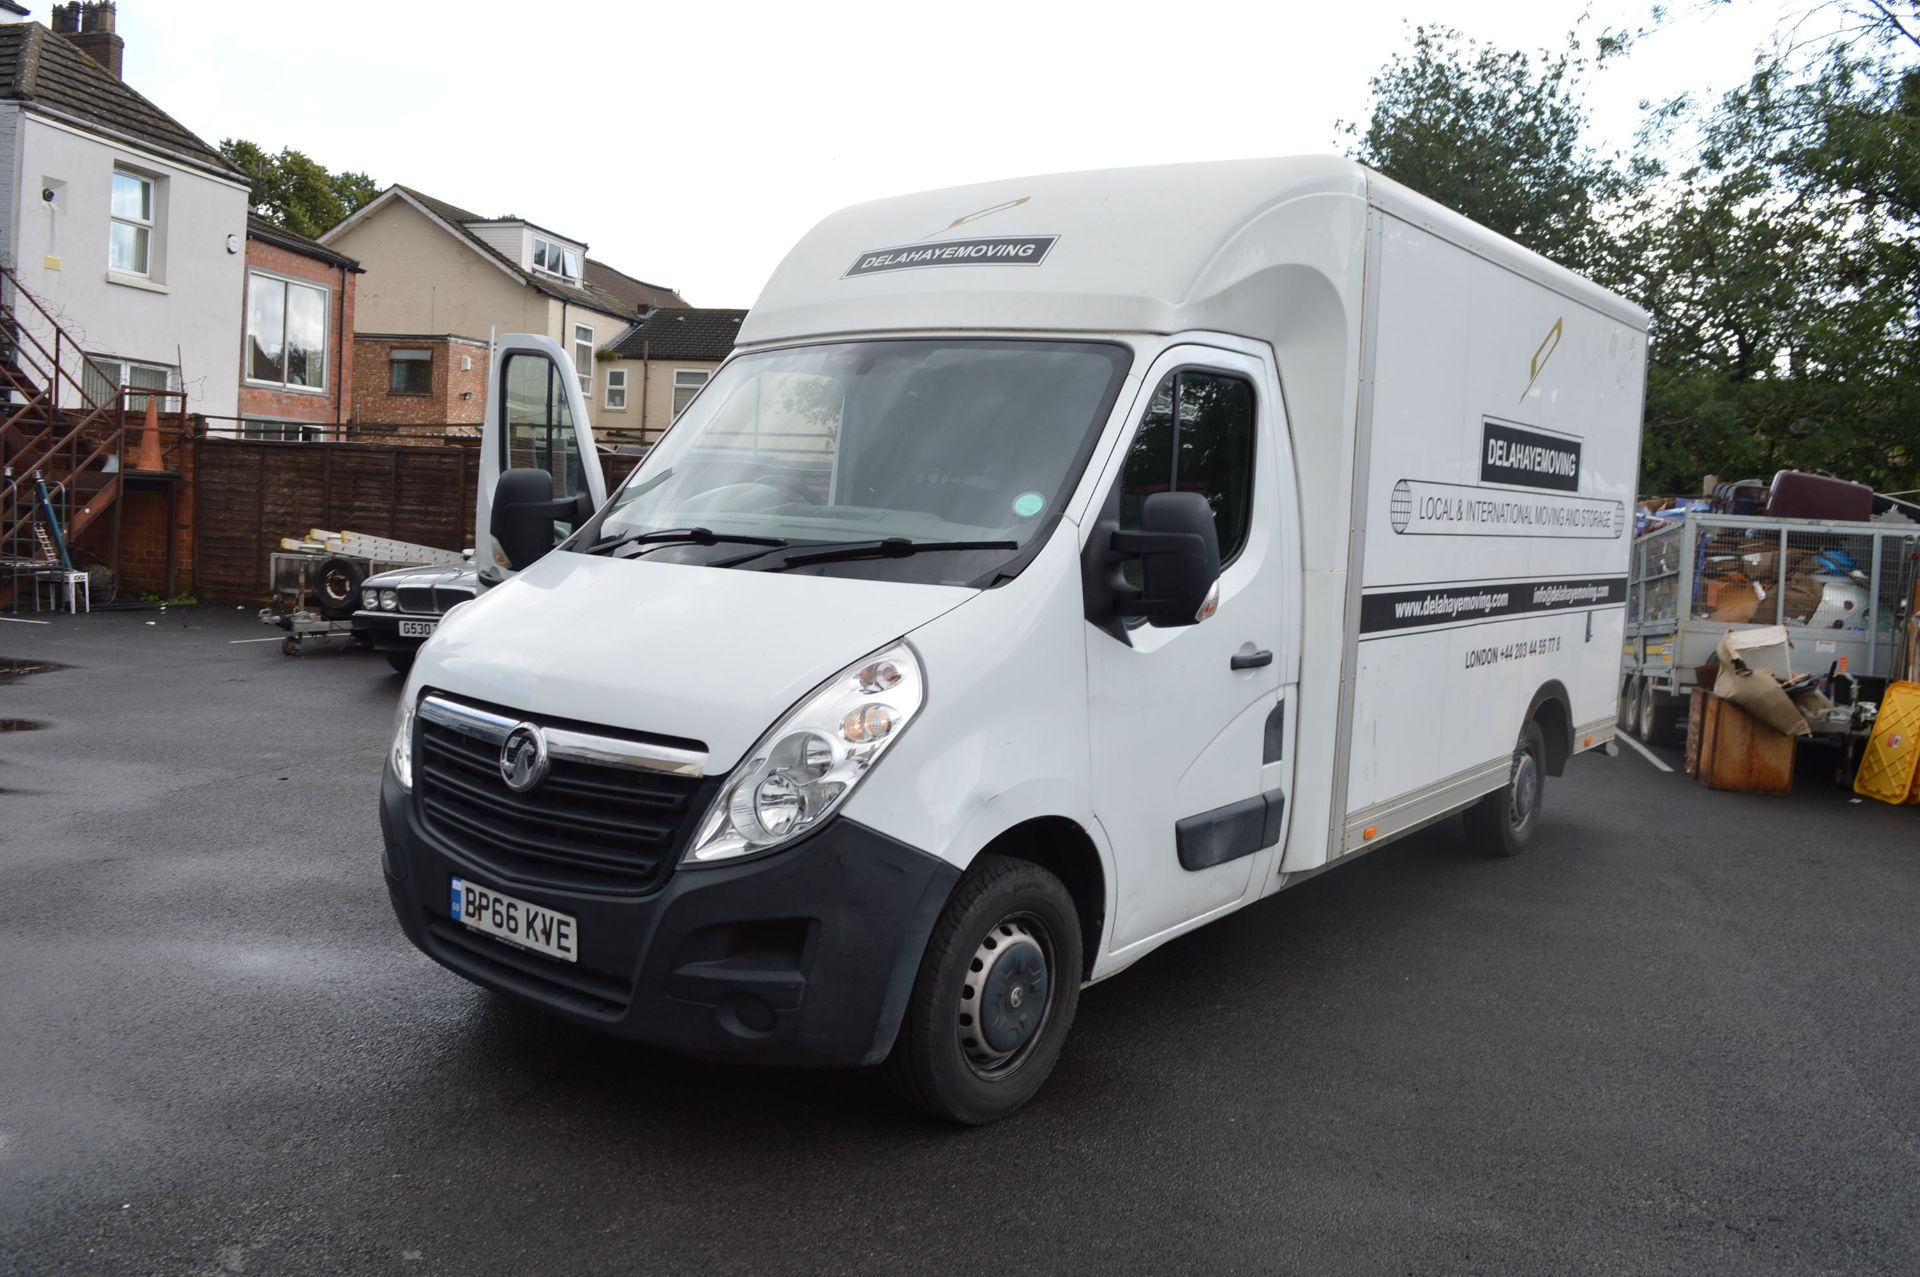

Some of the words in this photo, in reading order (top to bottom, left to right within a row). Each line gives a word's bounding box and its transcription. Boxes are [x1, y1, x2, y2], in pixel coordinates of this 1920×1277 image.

[860, 244, 1036, 269] DELAHAYEMOVING
[1487, 438, 1577, 477] DELAHAYEMOVING
[1419, 496, 1454, 521] LOCAL
[1456, 499, 1464, 521] &
[1465, 500, 1533, 525] INTERNATIONAL
[1535, 504, 1565, 526] MOVING
[1565, 508, 1581, 527] AND
[1581, 509, 1612, 528] STORAGE
[1395, 591, 1509, 619] www.delahayemoving.com
[403, 622, 431, 635] G530
[1465, 647, 1499, 669] LONDON
[1501, 644, 1513, 661] +44
[1528, 640, 1537, 657] 44
[465, 886, 518, 934] BP66
[525, 908, 572, 953] KVE
